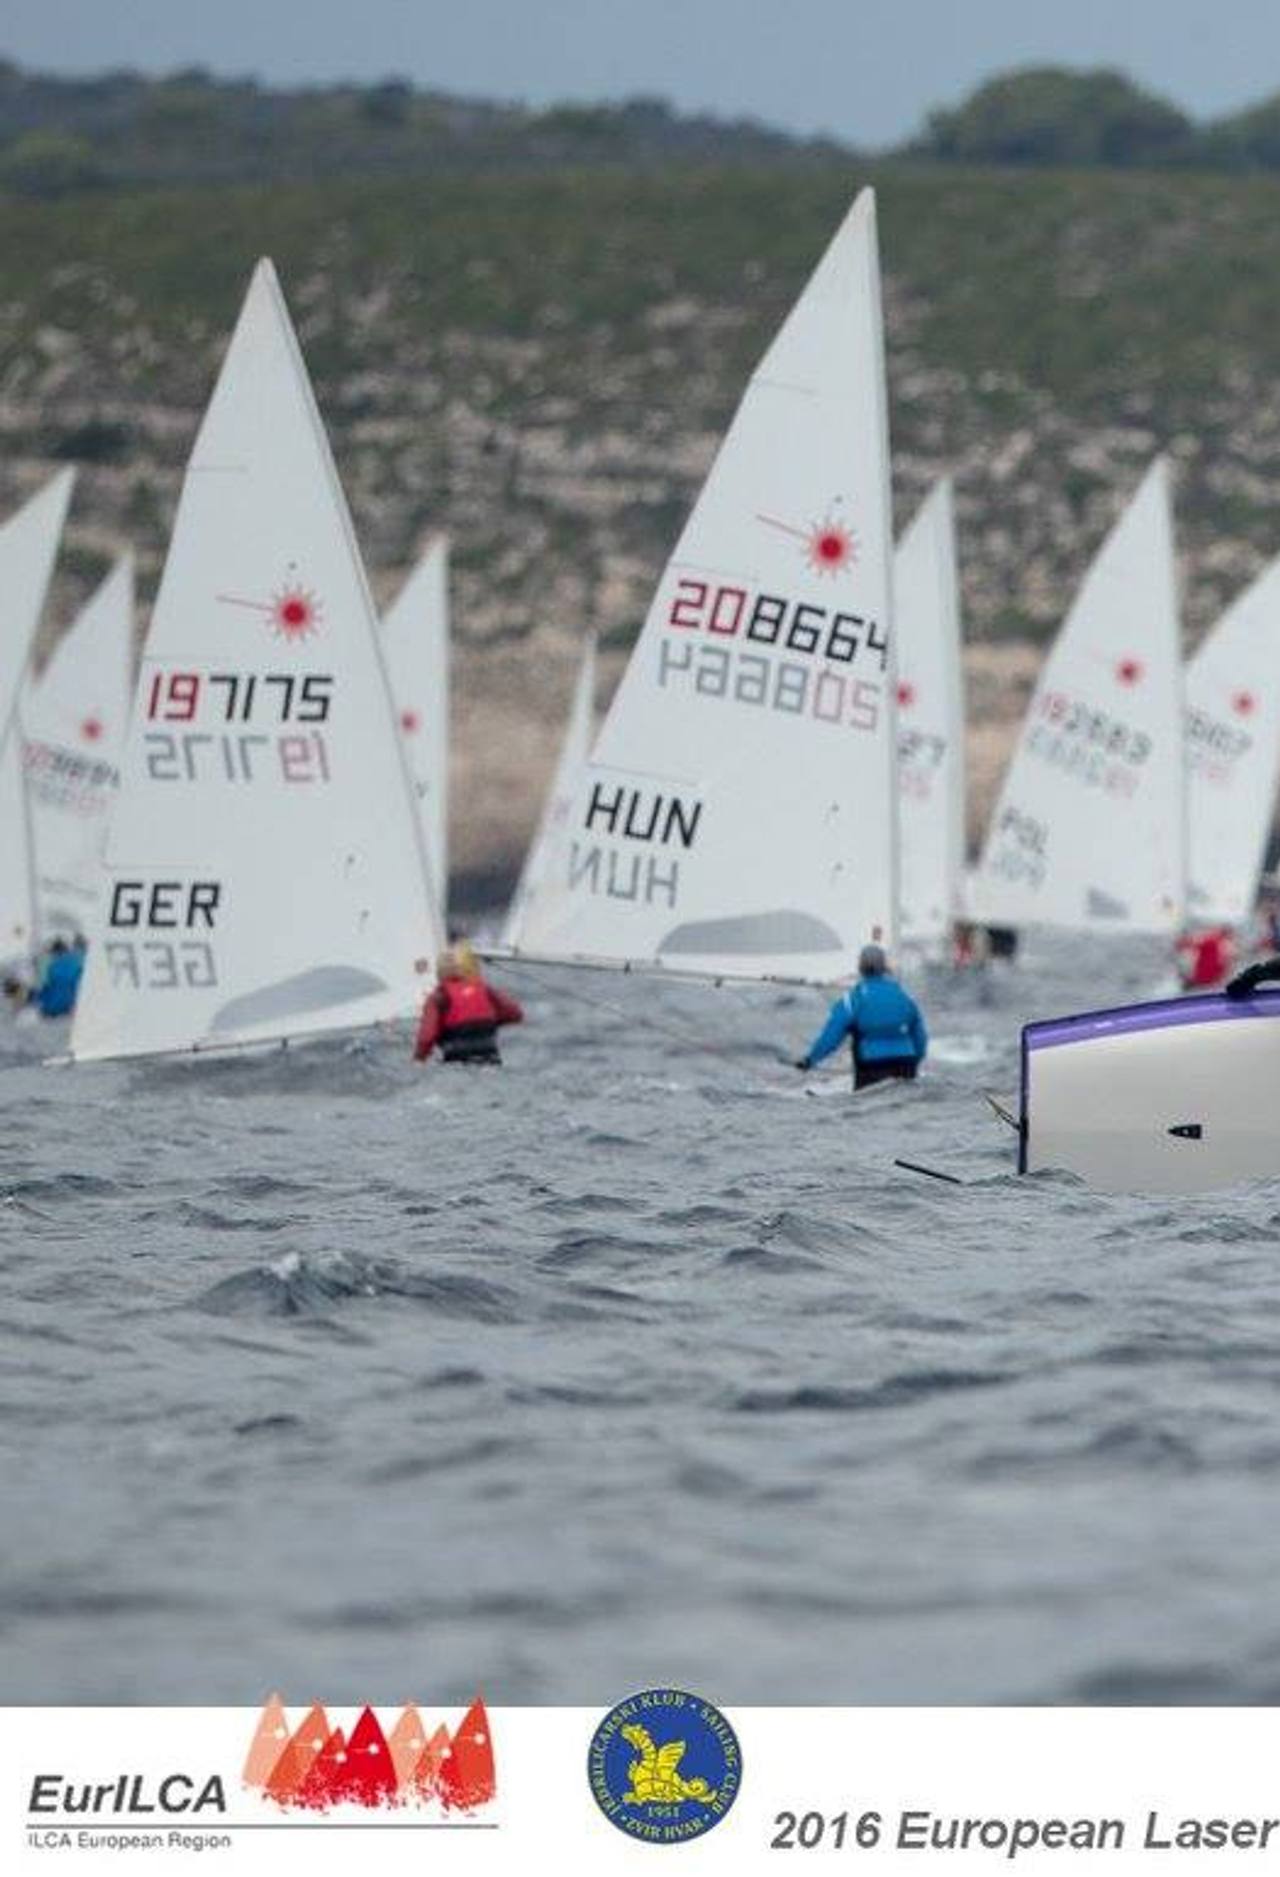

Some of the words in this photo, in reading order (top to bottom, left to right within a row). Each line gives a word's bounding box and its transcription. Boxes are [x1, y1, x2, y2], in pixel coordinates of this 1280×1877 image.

[669, 579, 889, 672] 208664
[146, 673, 334, 722] 197175
[584, 783, 703, 849] HUN
[109, 881, 222, 929] GER
